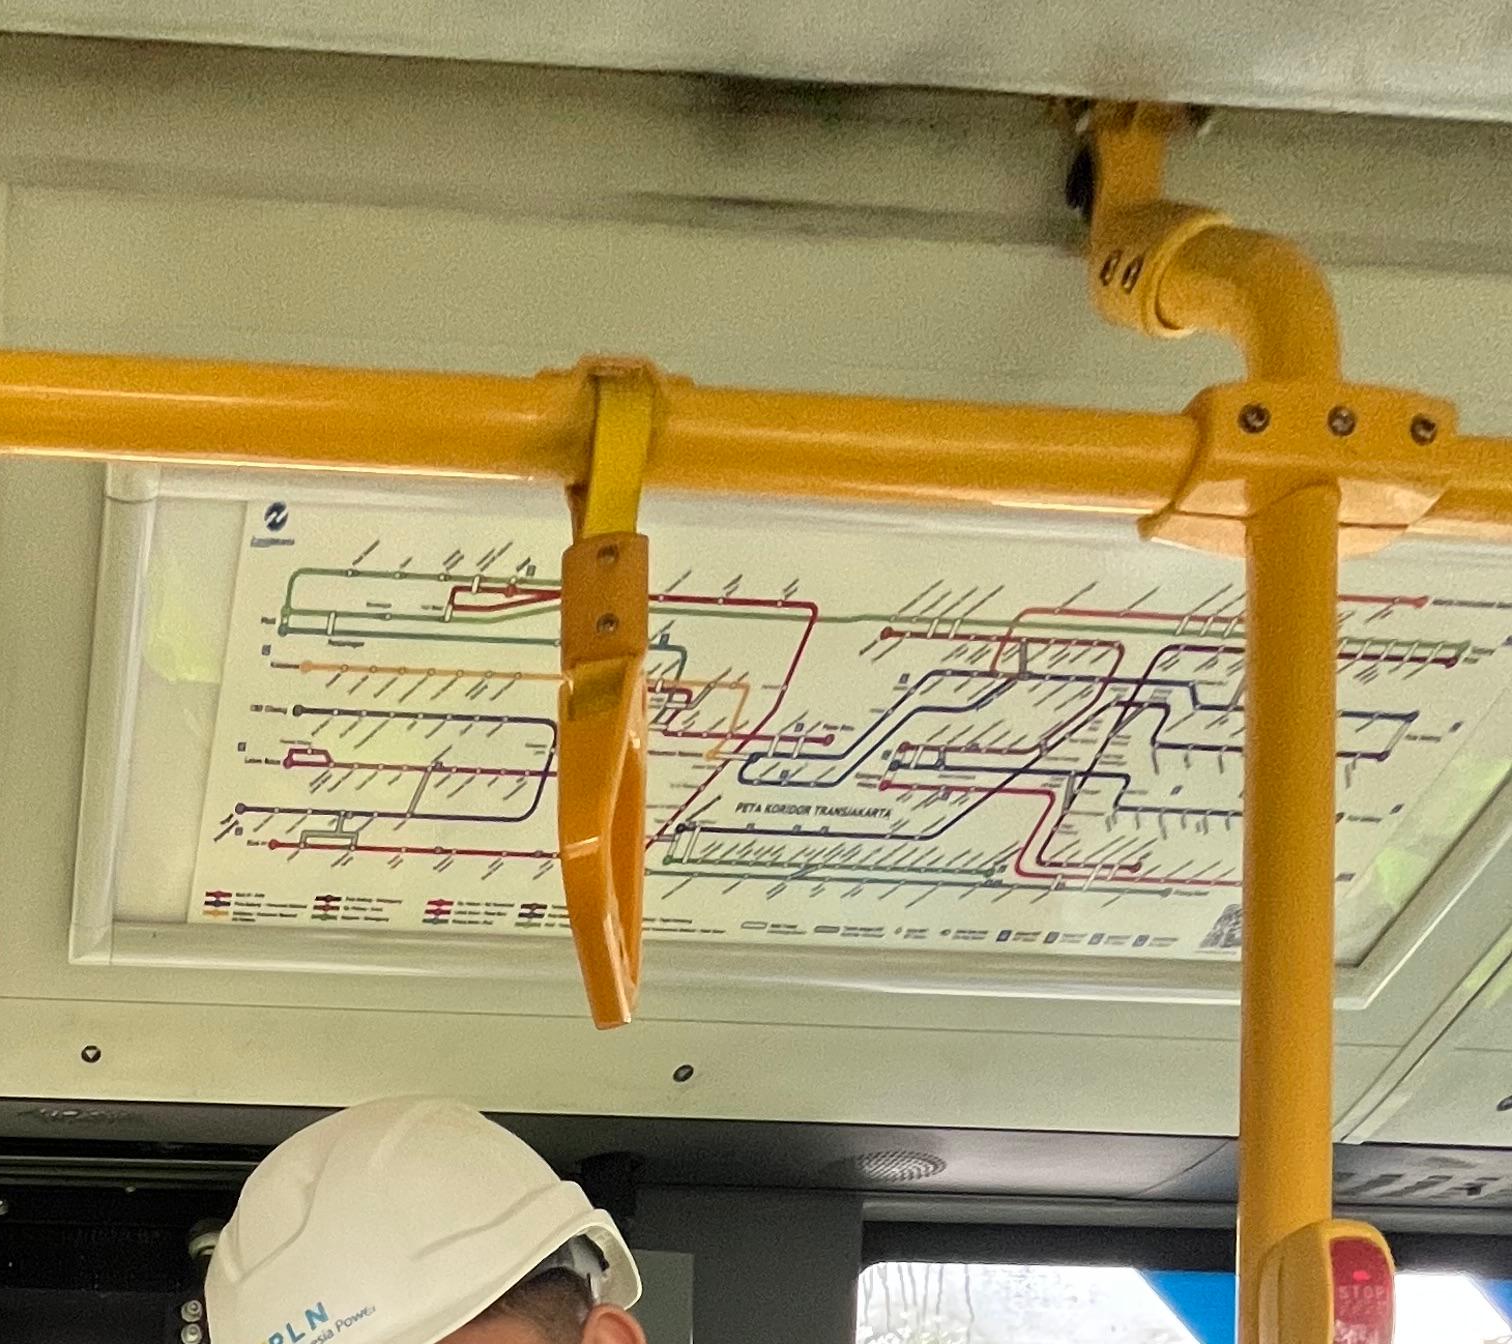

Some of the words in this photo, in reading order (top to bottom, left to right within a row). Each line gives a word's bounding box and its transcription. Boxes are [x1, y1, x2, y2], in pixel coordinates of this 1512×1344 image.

[735, 802, 761, 814] PETA
[764, 802, 812, 815] KORIDOR
[1339, 1285, 1385, 1299] STOP
